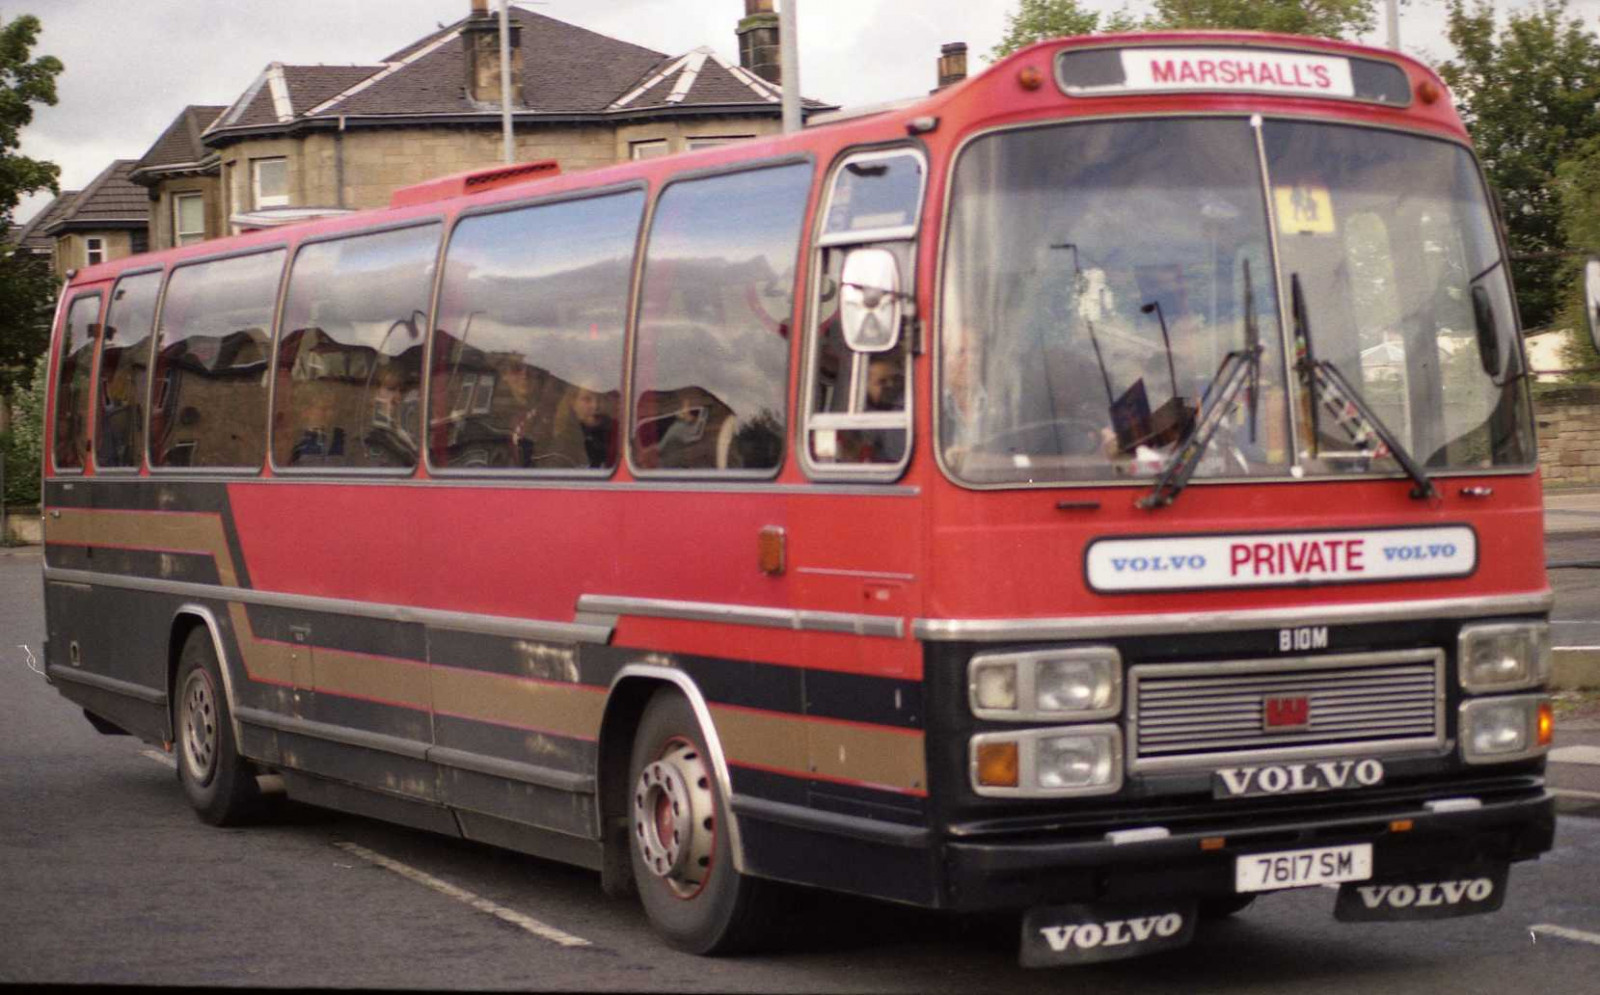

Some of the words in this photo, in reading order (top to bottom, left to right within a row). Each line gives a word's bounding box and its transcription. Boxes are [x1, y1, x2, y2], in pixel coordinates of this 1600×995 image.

[1150, 59, 1331, 89] MARSHALL'S
[1111, 554, 1206, 573] VOLVO
[1230, 539, 1365, 577] PRIVATE
[1383, 543, 1457, 562] VOLVO
[1278, 627, 1329, 651] B10M
[1216, 758, 1384, 795] VOLVO
[1257, 852, 1314, 884] 7617
[1320, 850, 1353, 877] SM
[1357, 877, 1494, 908] VOLVO
[1039, 912, 1183, 951] VOLVO
